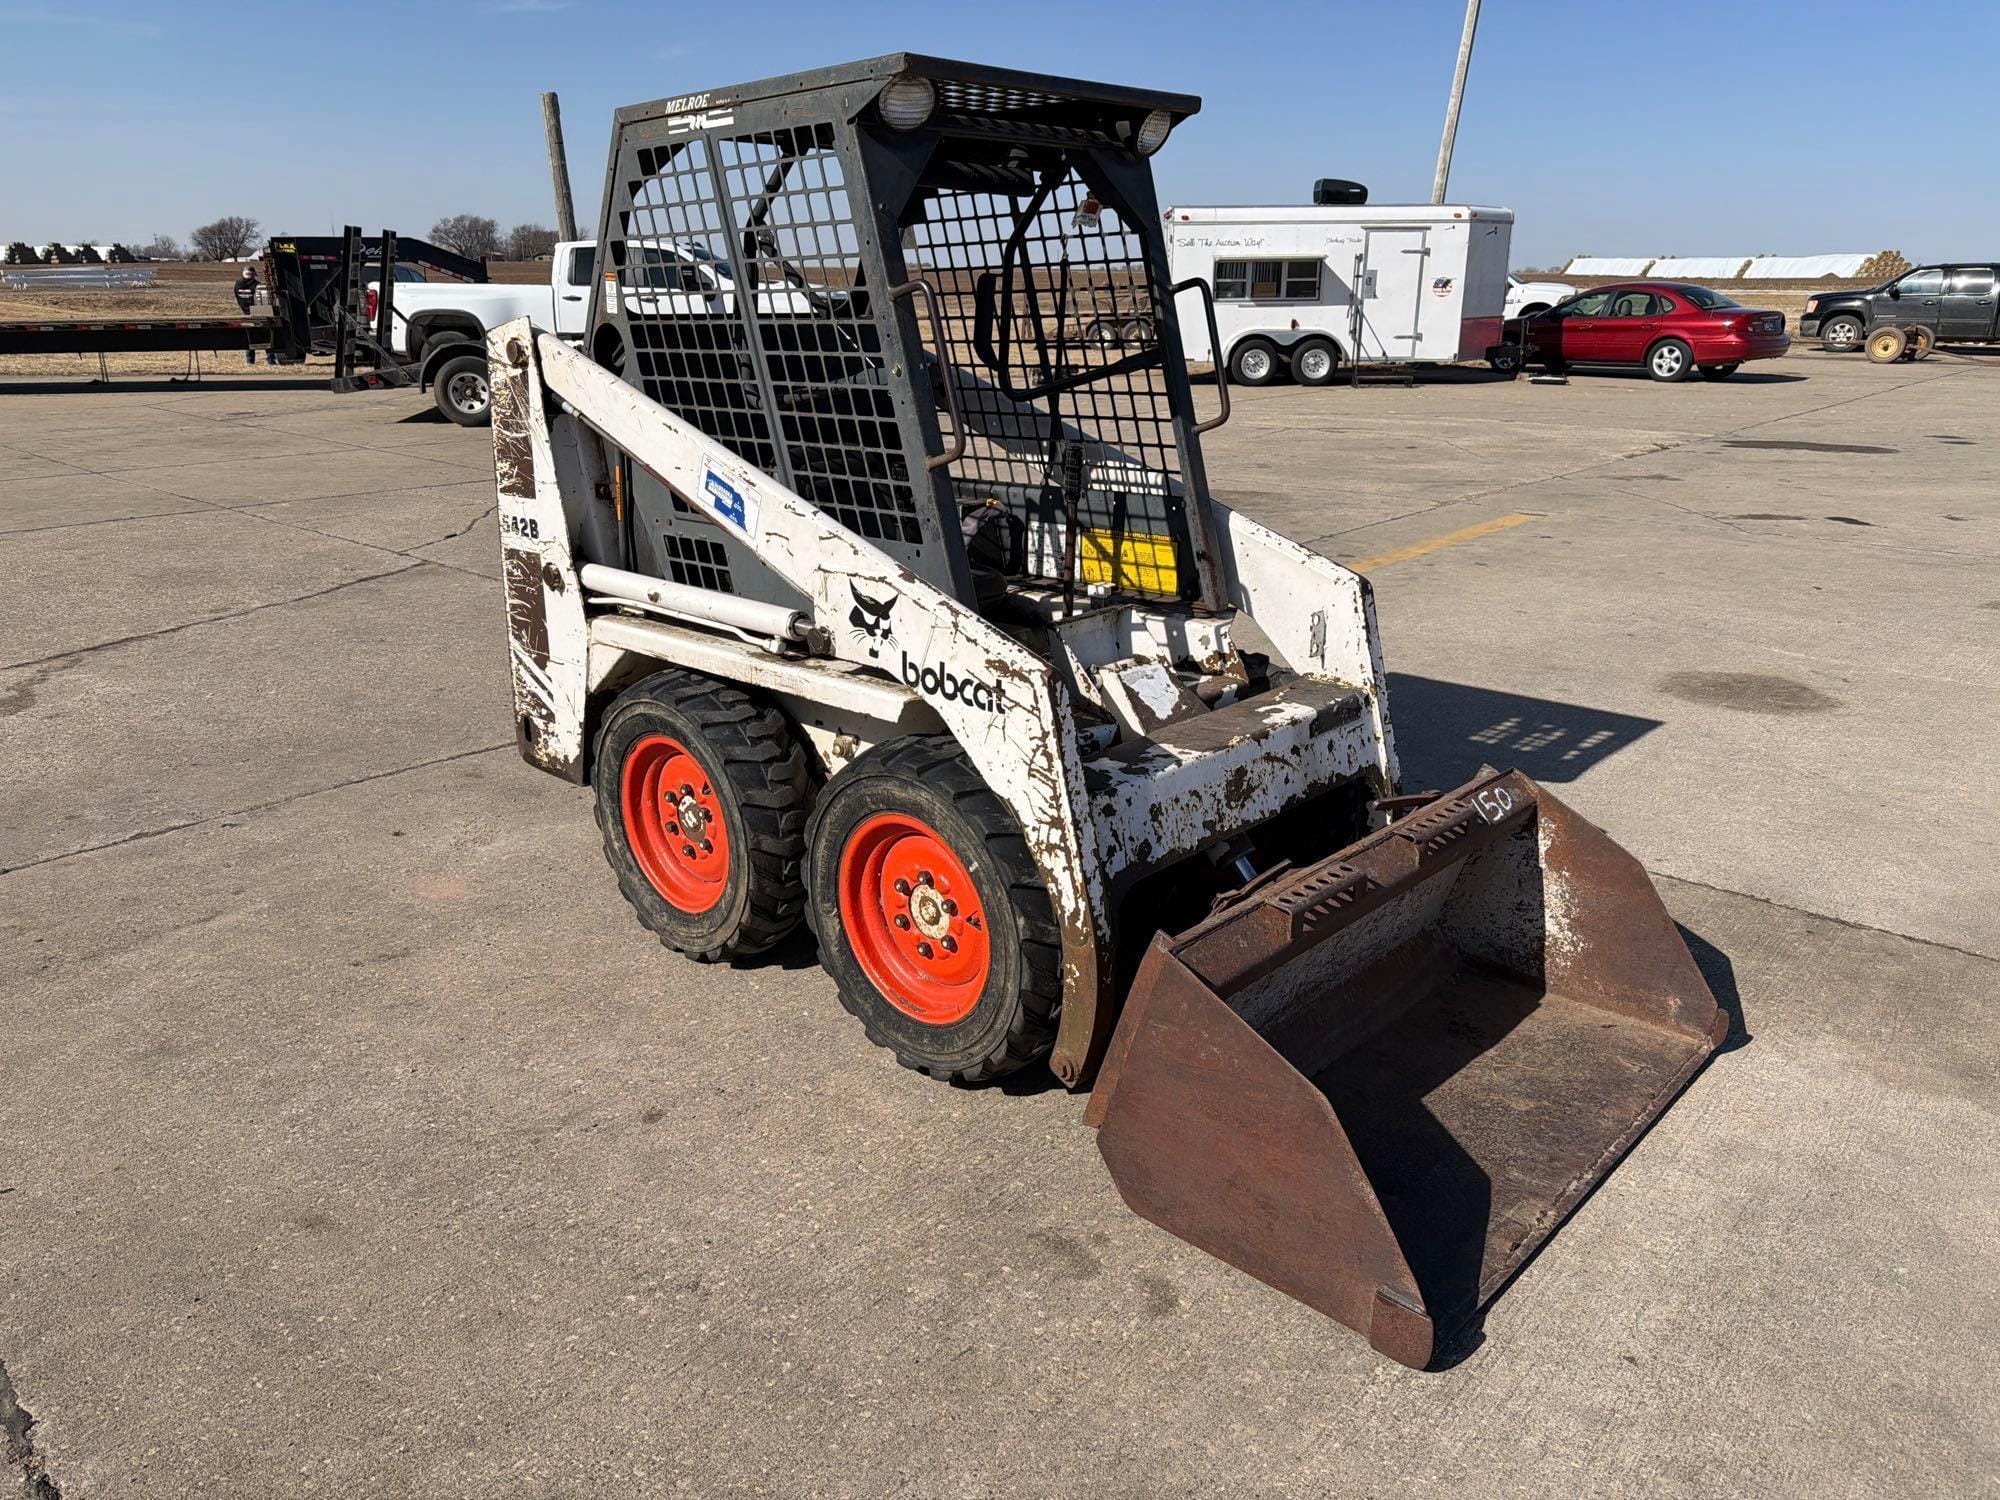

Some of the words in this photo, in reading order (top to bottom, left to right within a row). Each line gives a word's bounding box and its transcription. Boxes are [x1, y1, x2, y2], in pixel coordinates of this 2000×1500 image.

[665, 94, 710, 114] MELROE
[1198, 238, 1213, 248] The
[1215, 238, 1241, 247] Auction
[902, 650, 1006, 714] bobcat
[1471, 787, 1513, 826] 150
